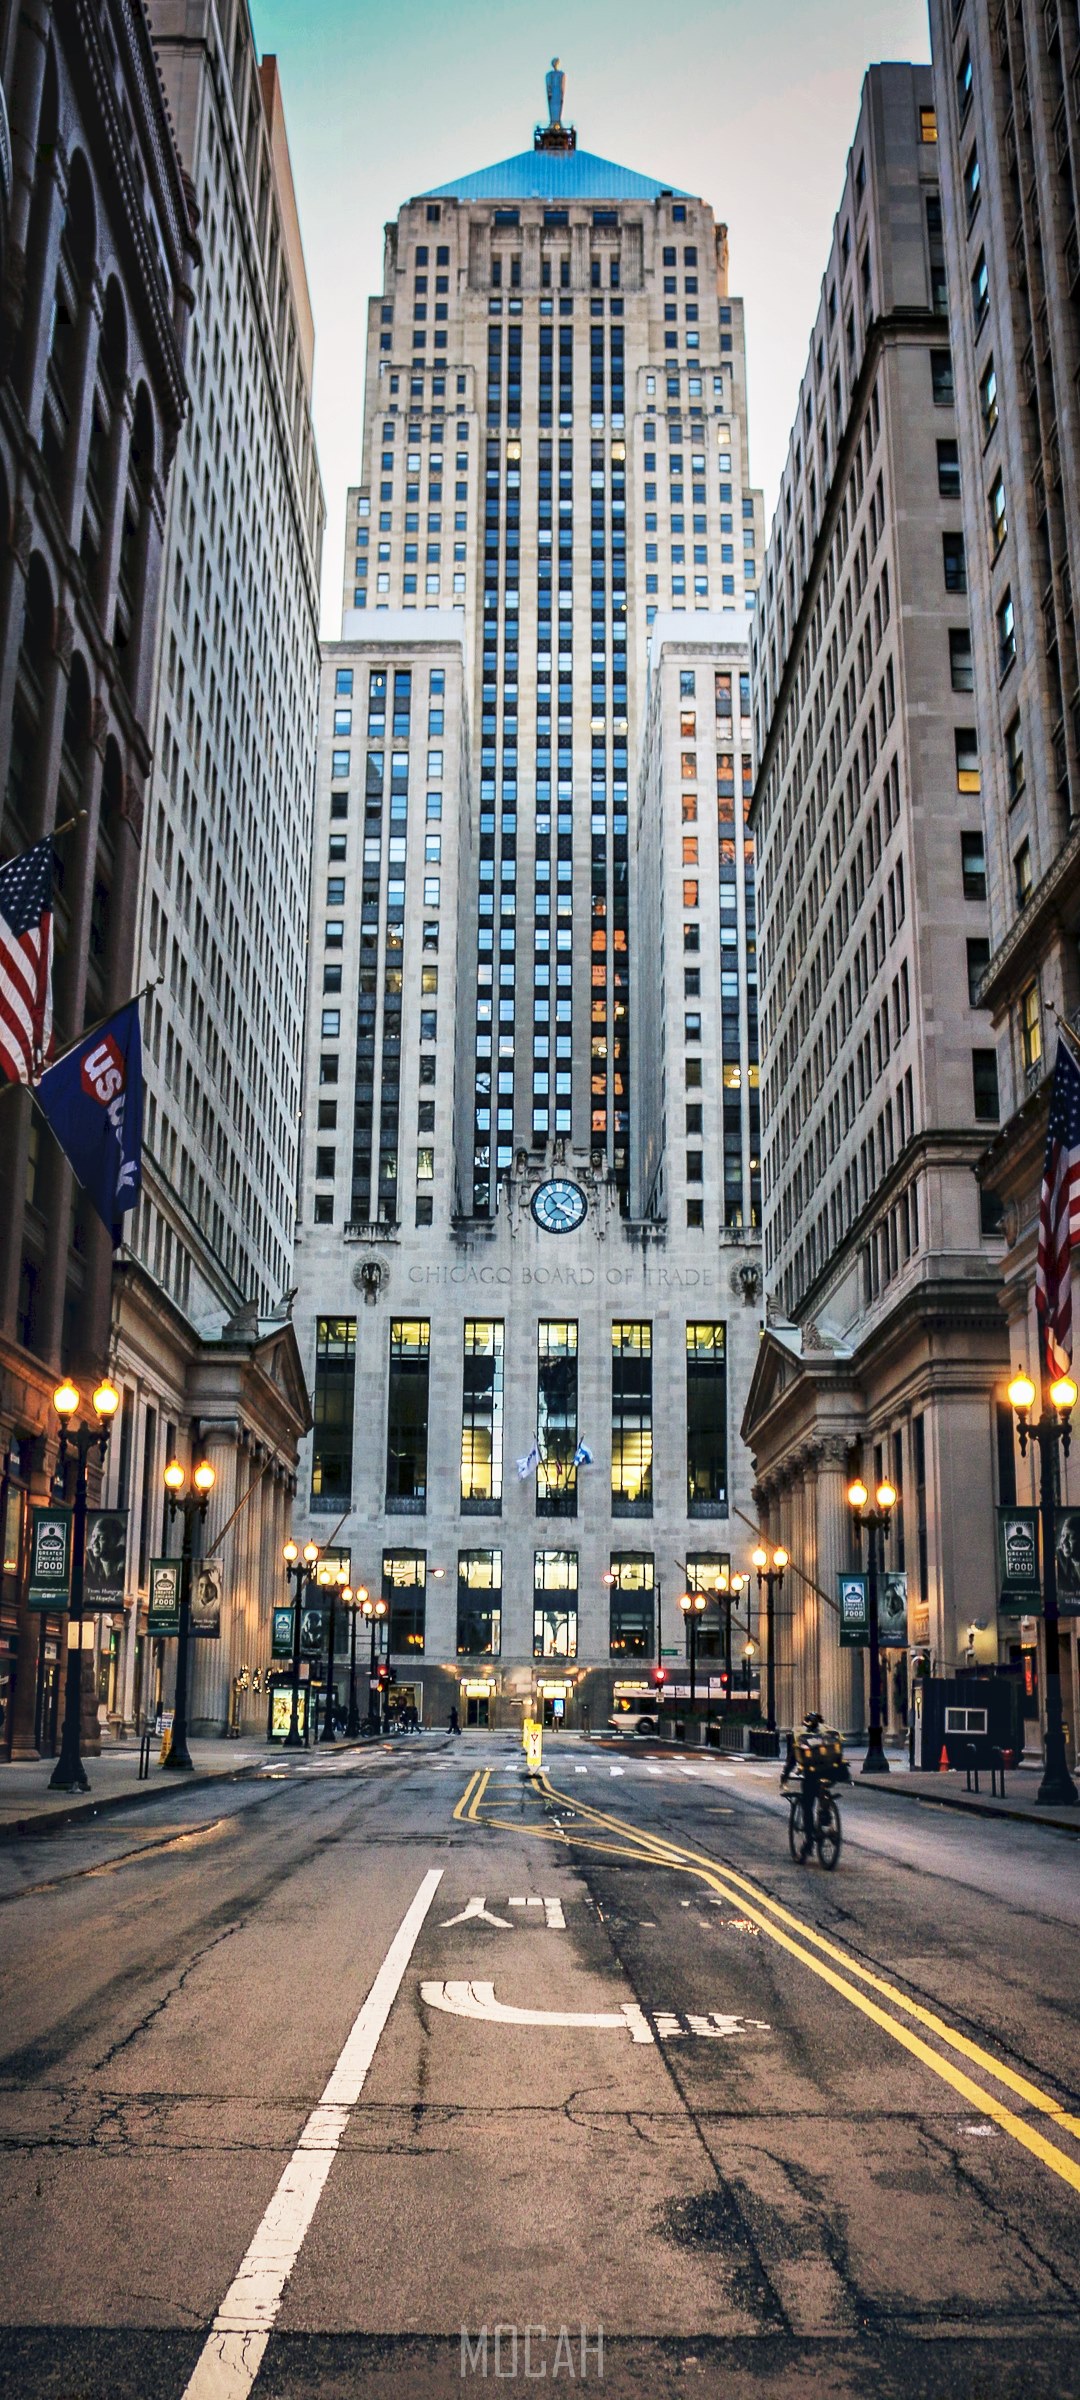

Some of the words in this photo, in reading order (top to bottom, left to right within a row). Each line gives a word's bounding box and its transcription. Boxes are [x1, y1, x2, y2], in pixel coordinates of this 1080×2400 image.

[408, 1265, 512, 1284] CHICAGO
[521, 1266, 595, 1285] BOARD
[605, 1267, 634, 1285] OF
[646, 1267, 714, 1287] TRADE
[37, 1561, 63, 1570] FOOD
[1008, 1562, 1033, 1571] FOOD
